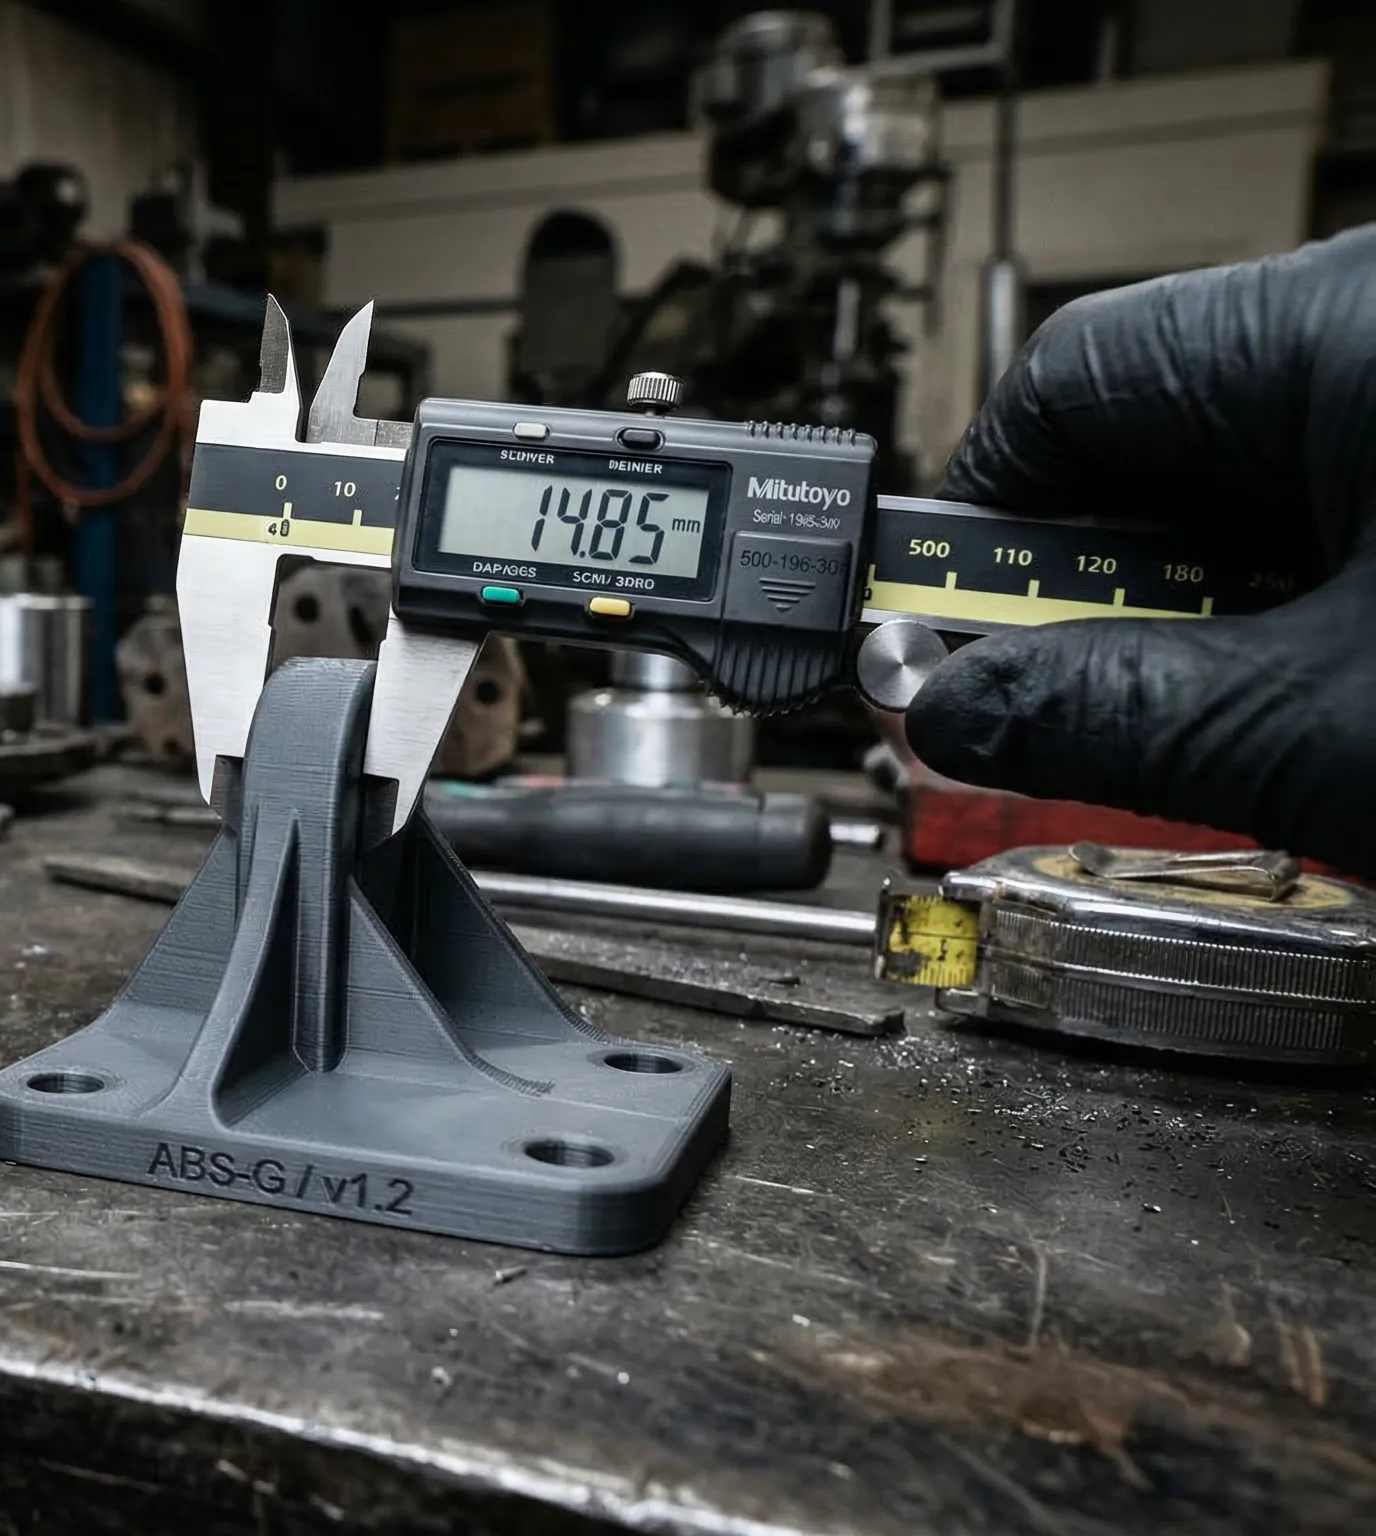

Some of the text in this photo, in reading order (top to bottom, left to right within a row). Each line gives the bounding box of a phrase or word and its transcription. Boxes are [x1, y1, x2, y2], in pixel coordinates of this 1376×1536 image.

[275, 475, 356, 497] 0 10
[747, 477, 851, 511] Mitutoyo
[532, 484, 701, 565] 14.85 mm
[740, 550, 852, 576] 500-196-30
[908, 539, 950, 558] 500
[993, 547, 1033, 566] 110
[1076, 555, 1117, 574] 120
[1163, 564, 1204, 582] 180
[147, 1142, 285, 1194] ABS-G
[322, 1172, 414, 1216] v1.2
